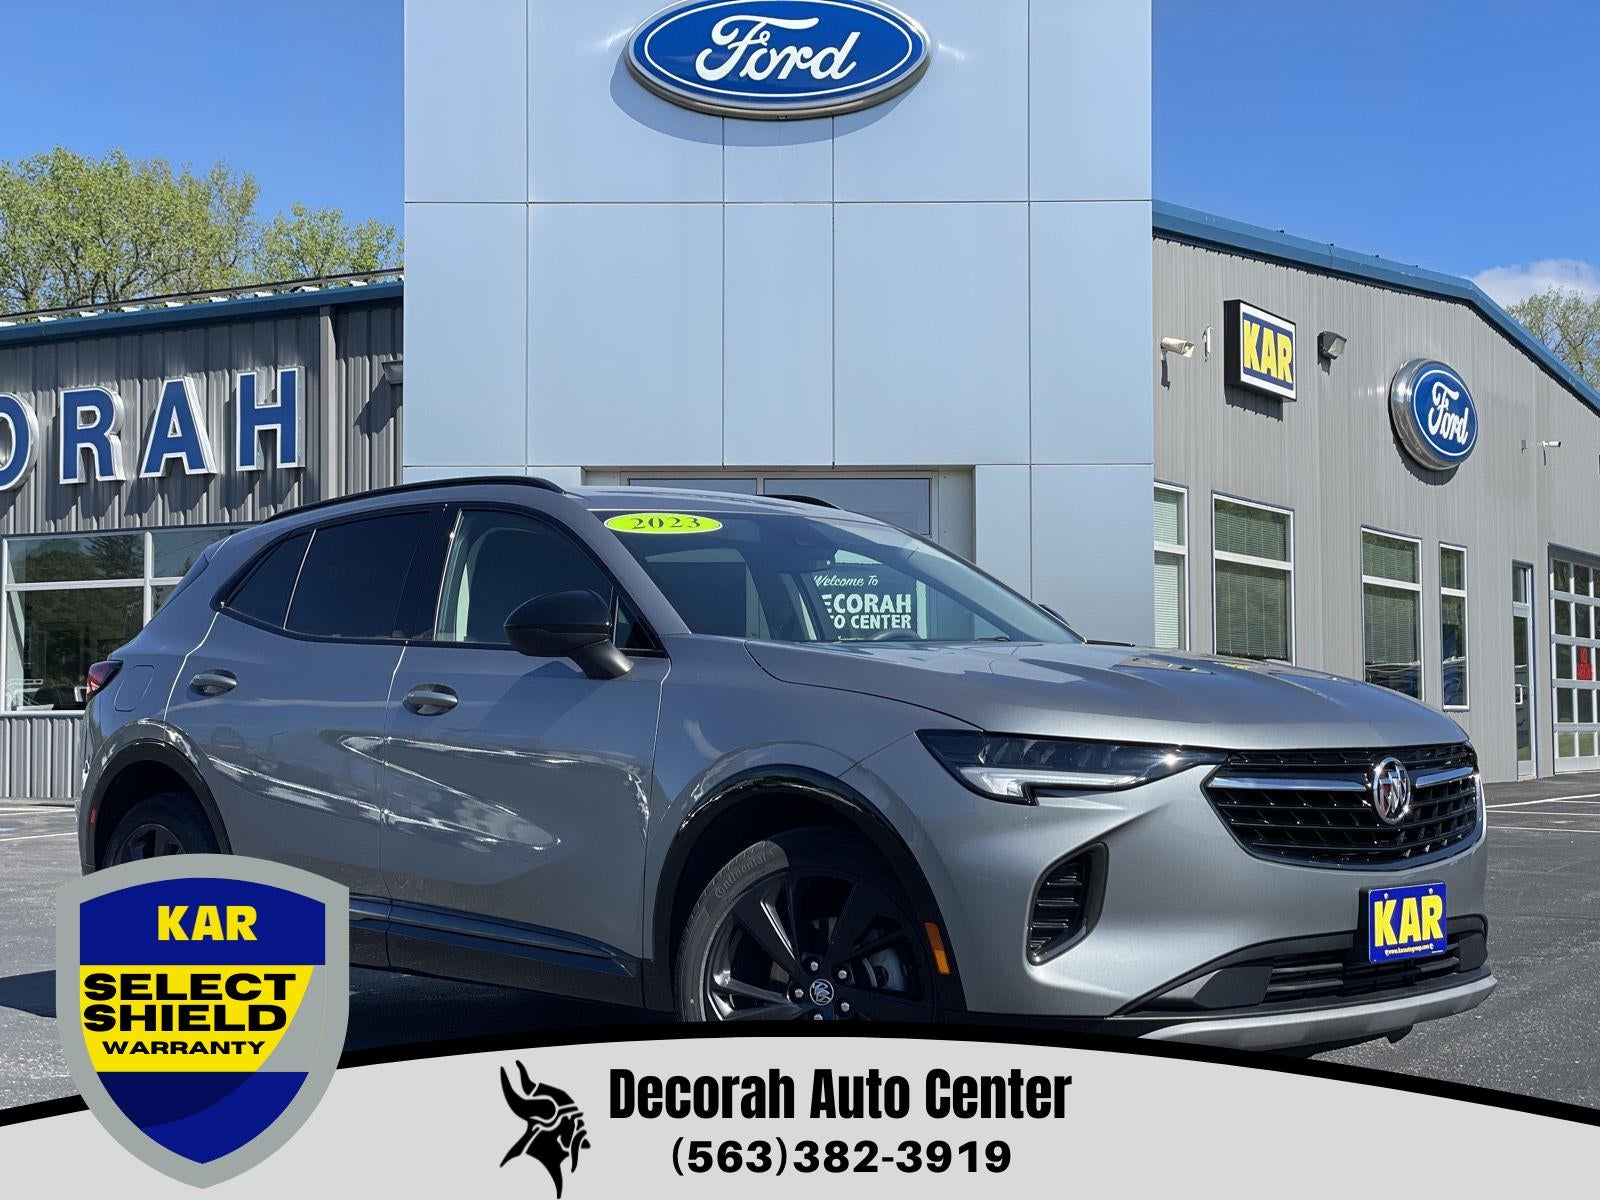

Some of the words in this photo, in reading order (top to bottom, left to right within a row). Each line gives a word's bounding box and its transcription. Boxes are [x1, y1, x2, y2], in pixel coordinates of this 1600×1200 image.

[695, 14, 861, 81] Ford
[1242, 318, 1293, 384] KAR
[1427, 380, 1469, 445] Ford
[630, 516, 701, 530] 2023
[813, 574, 865, 588] Welcome
[867, 575, 879, 586] To
[850, 614, 912, 630] CENTER
[1374, 894, 1444, 947] KAR
